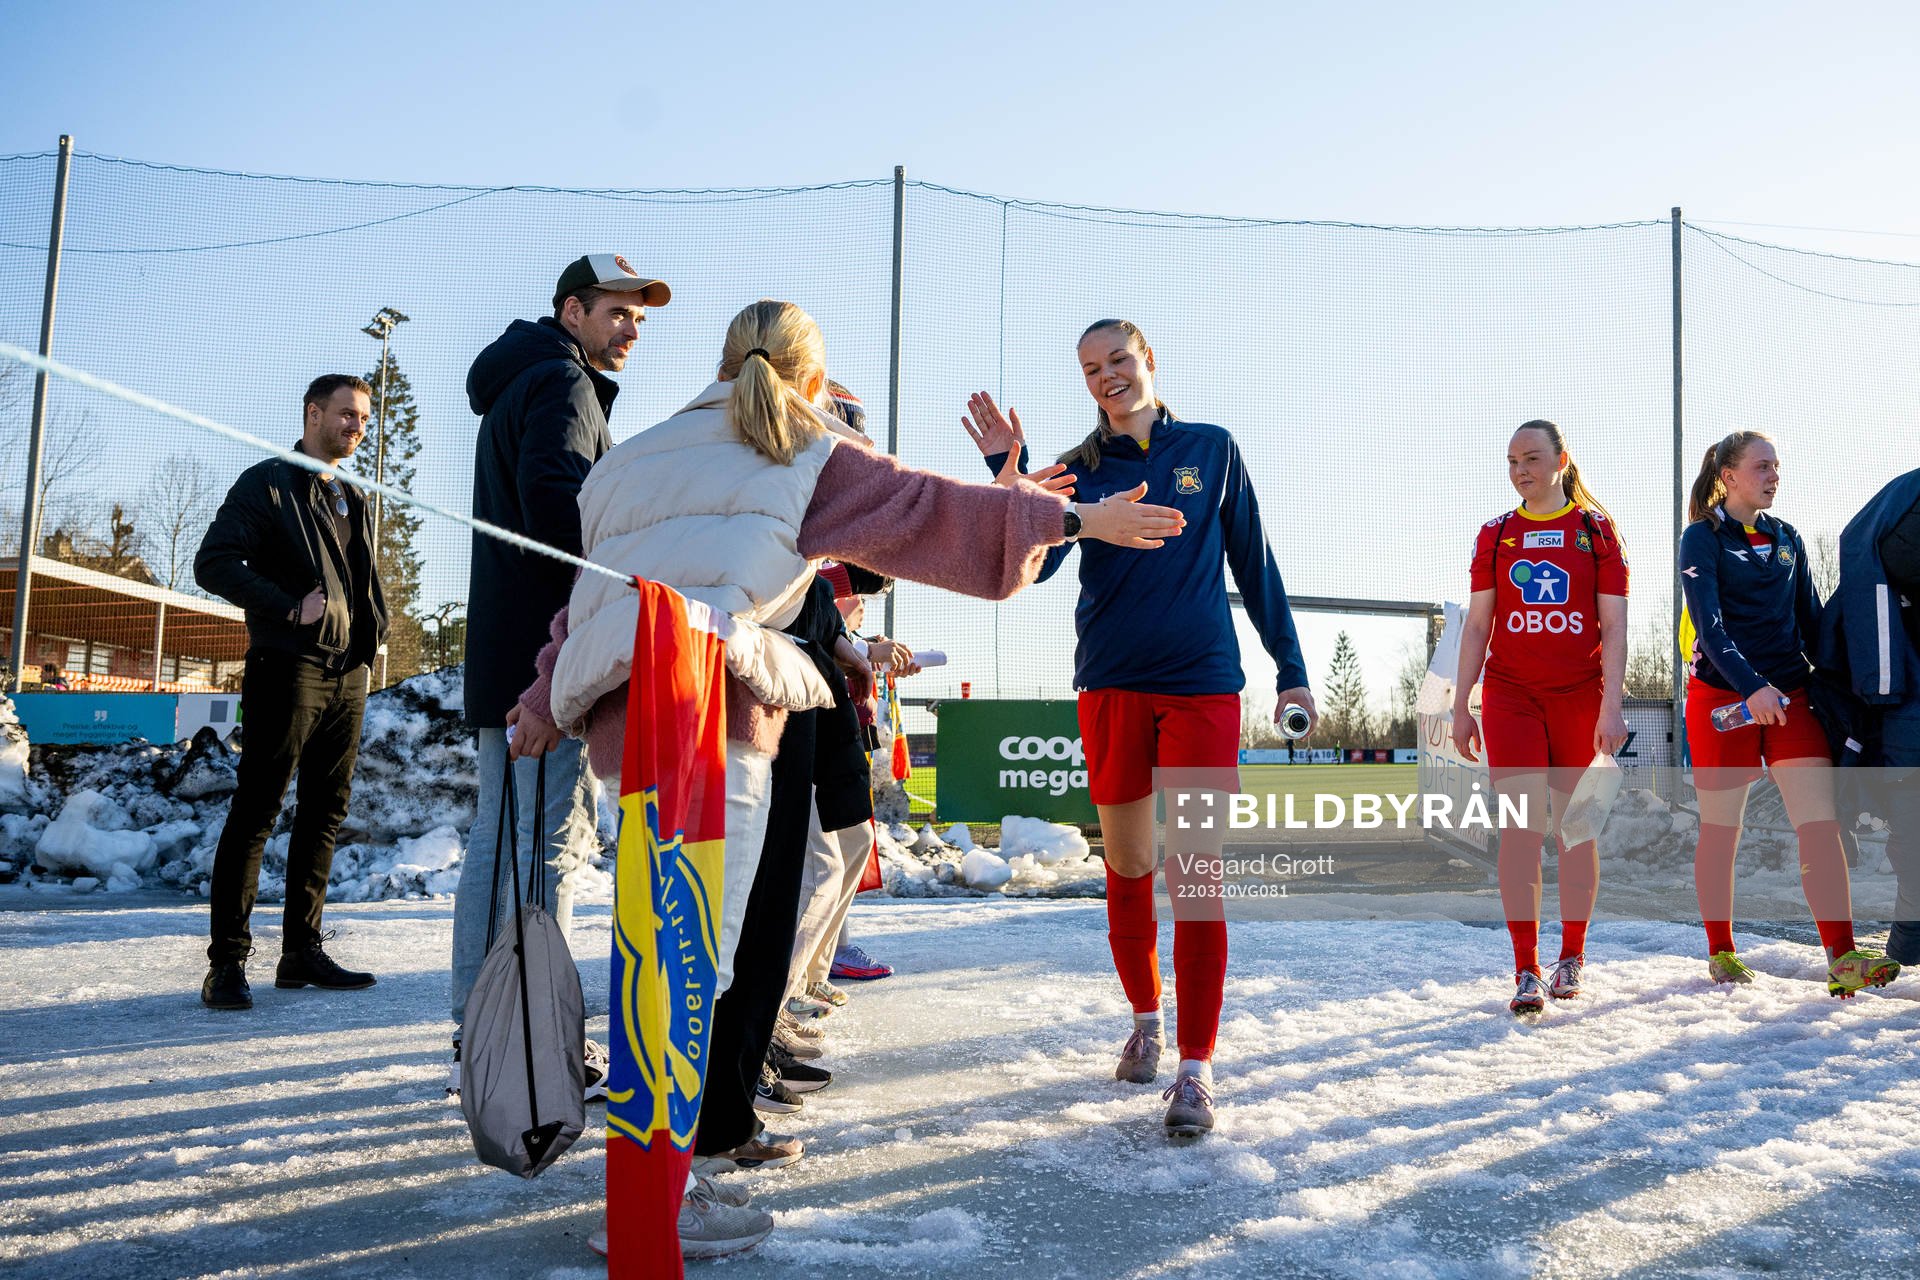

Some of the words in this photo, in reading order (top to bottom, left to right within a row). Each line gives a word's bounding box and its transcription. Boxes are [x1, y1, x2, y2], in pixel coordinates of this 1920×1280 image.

[1538, 537, 1562, 546] RSM
[1507, 610, 1584, 634] OBOS
[999, 736, 1086, 766] coop
[1000, 769, 1088, 796] mega
